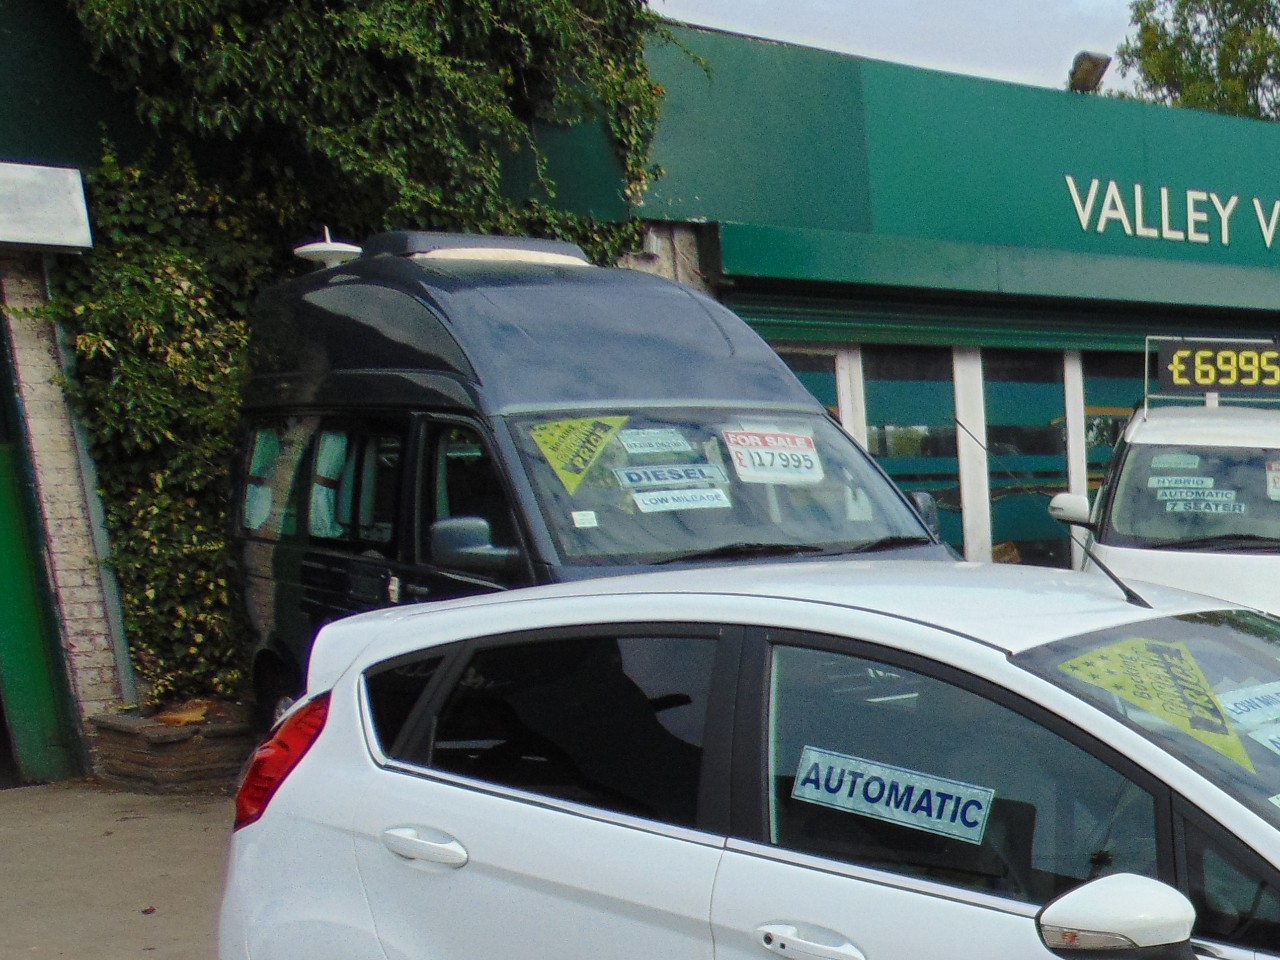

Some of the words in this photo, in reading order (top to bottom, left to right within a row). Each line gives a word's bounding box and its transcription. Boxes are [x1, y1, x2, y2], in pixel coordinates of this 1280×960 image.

[1065, 174, 1239, 246] VALLEY
[727, 433, 762, 447] FOR
[763, 434, 807, 448] SALE
[625, 468, 714, 484] DIESEL
[1156, 478, 1204, 486] HYBRID
[642, 496, 670, 506] LOW
[1159, 490, 1233, 499] AUTOMATIC
[1168, 502, 1177, 512] 7
[1183, 501, 1243, 513] SEATER
[1228, 693, 1262, 716] LOW
[803, 763, 982, 828] AUTOMATIC
